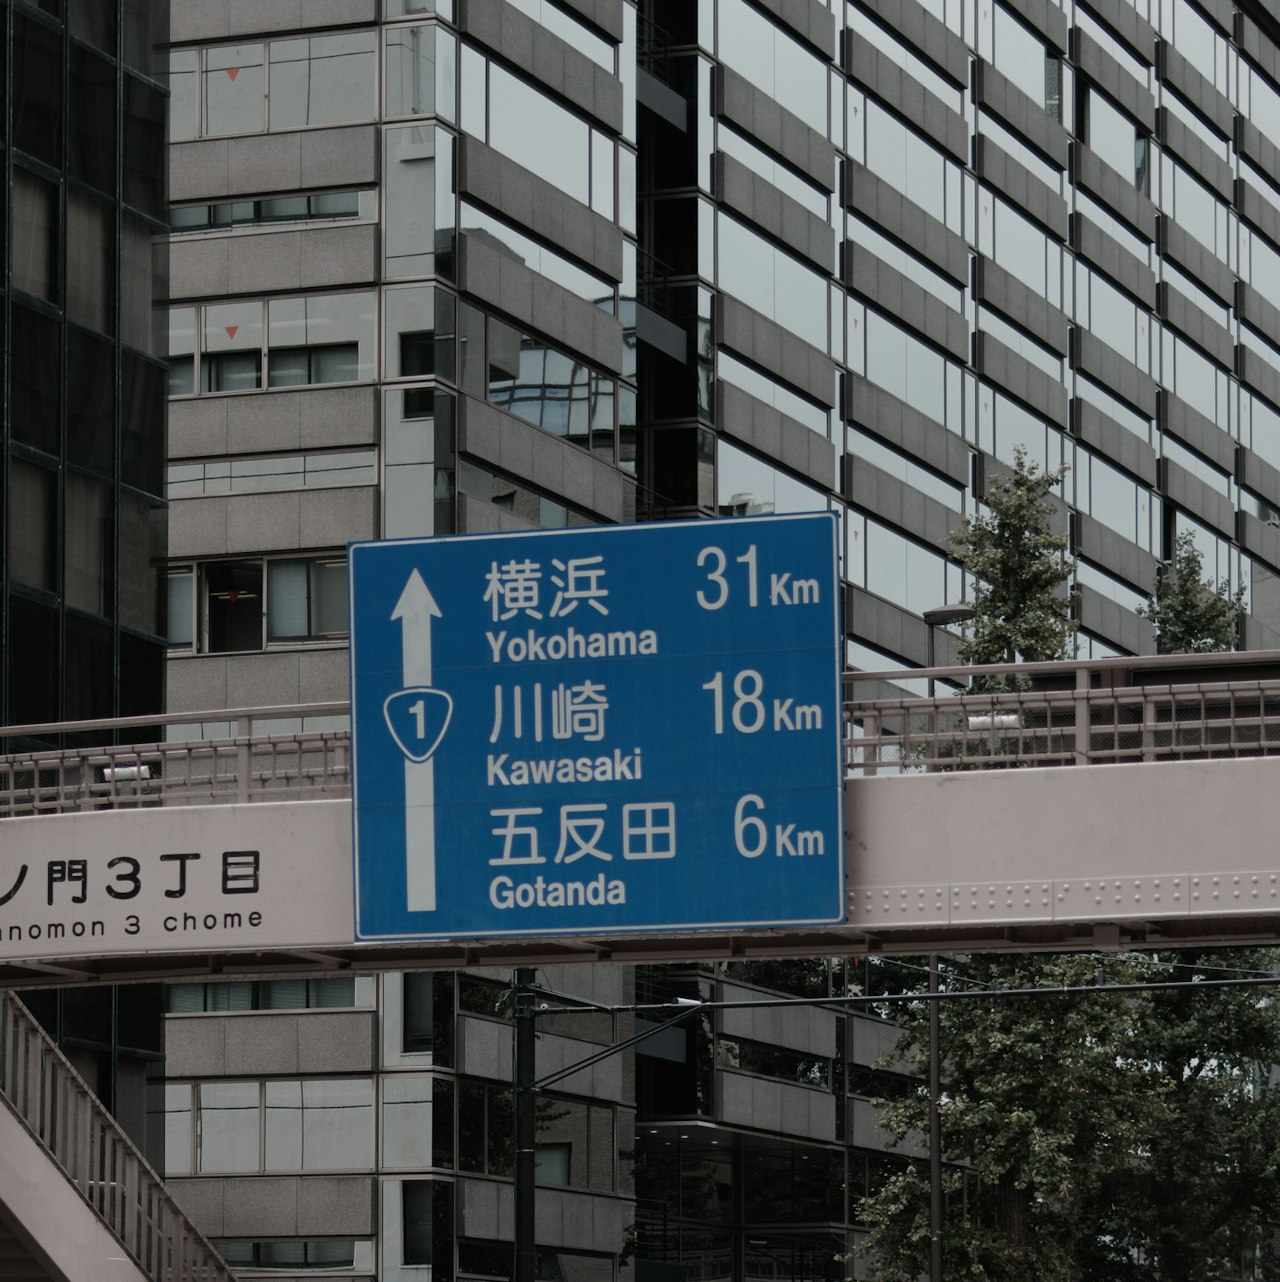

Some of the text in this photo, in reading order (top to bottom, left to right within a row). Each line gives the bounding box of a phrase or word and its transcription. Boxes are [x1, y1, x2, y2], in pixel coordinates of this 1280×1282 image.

[483, 555, 609, 622] 横浜
[486, 627, 658, 663] Yokohama
[408, 701, 425, 739] 1
[489, 680, 609, 743] 川崎
[487, 747, 642, 786] Kawasaki
[488, 802, 676, 866] 五反田
[489, 873, 626, 911] Gotanda
[124, 915, 141, 935] 3
[163, 910, 263, 932] chome
